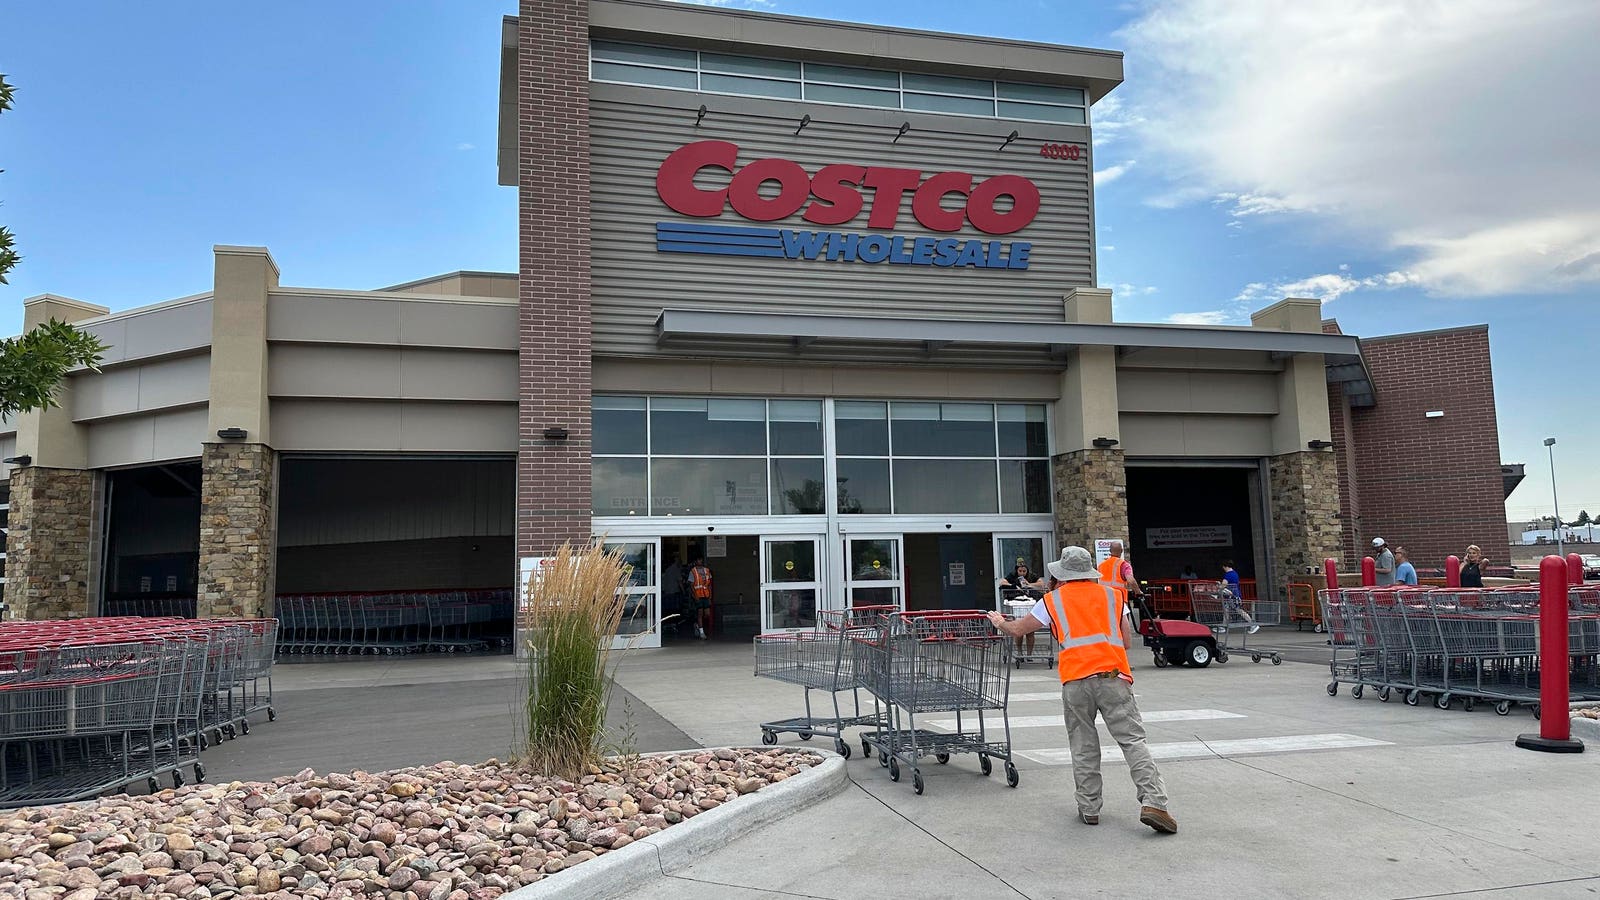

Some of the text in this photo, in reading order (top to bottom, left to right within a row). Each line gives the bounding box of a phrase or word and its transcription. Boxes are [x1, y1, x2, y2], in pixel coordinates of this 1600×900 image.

[1040, 143, 1080, 161] 4000
[656, 140, 1041, 234] COSTCO
[779, 229, 1032, 270] WHOLESALE
[612, 497, 679, 507] ENTRNCE
